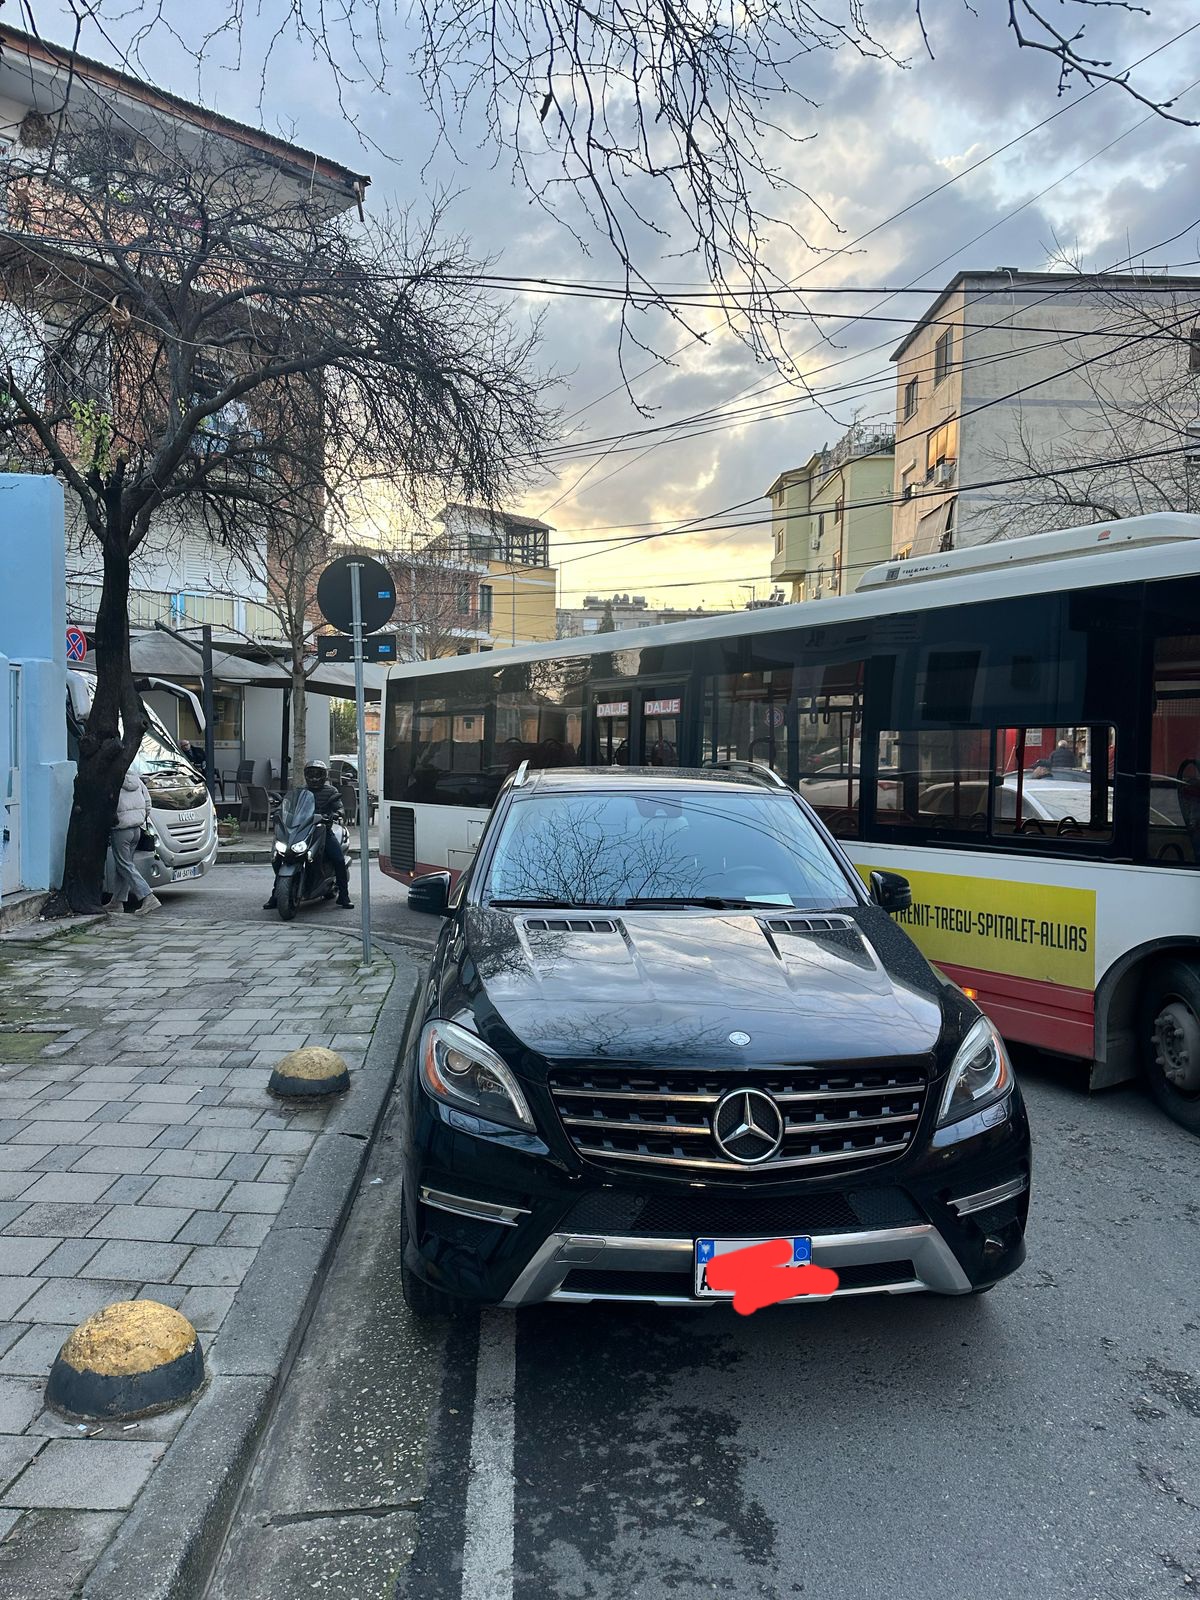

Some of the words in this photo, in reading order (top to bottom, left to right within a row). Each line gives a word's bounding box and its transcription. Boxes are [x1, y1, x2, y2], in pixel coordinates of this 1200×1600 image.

[599, 702, 628, 715] DALJE
[646, 700, 679, 713] DALJE
[178, 812, 195, 821] IVECO
